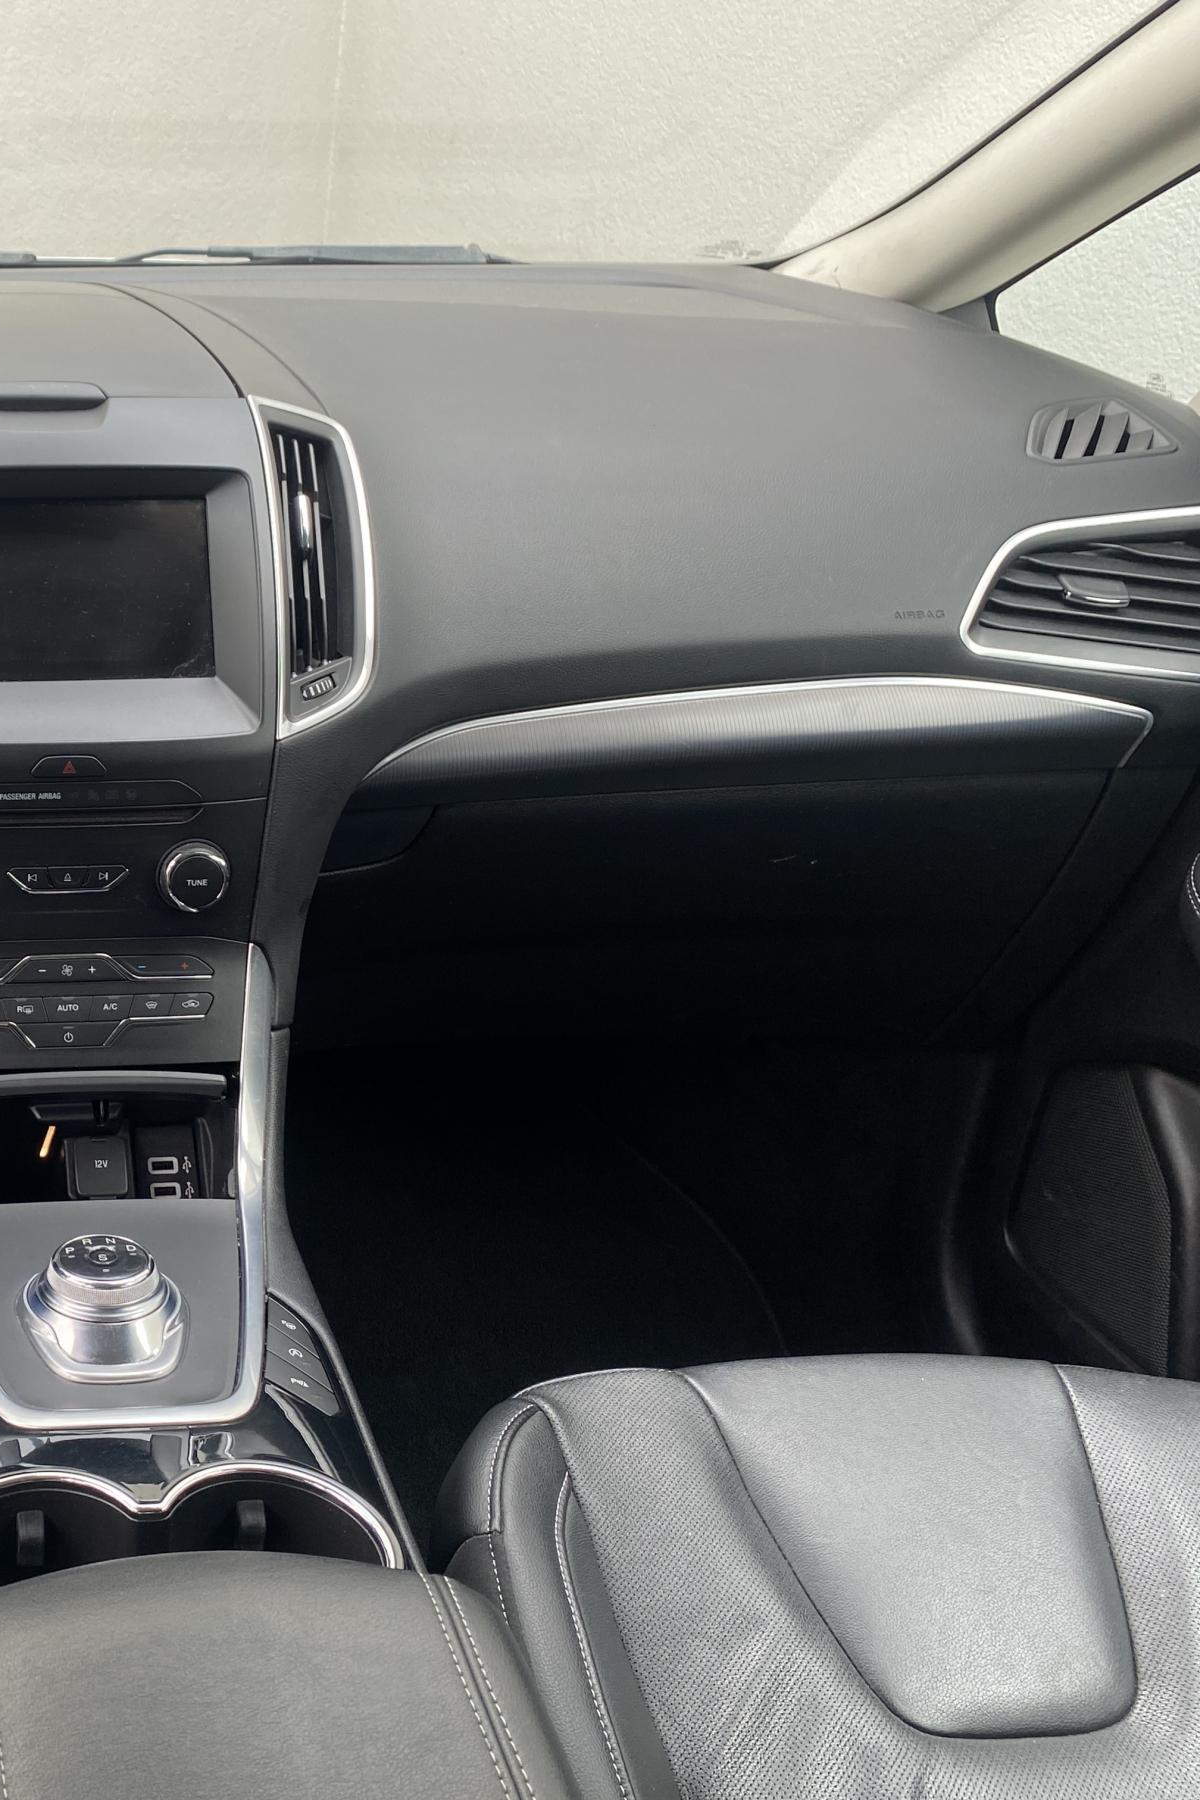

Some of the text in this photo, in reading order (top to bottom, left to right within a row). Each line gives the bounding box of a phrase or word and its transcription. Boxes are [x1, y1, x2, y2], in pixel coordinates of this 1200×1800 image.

[894, 609, 945, 619] AIRBAG
[38, 792, 62, 800] AIRBAG
[186, 878, 208, 887] TUNE
[57, 1003, 79, 1012] AUTO
[103, 1003, 118, 1011] A/C
[94, 1159, 110, 1169] 12V
[125, 1244, 137, 1252] D
